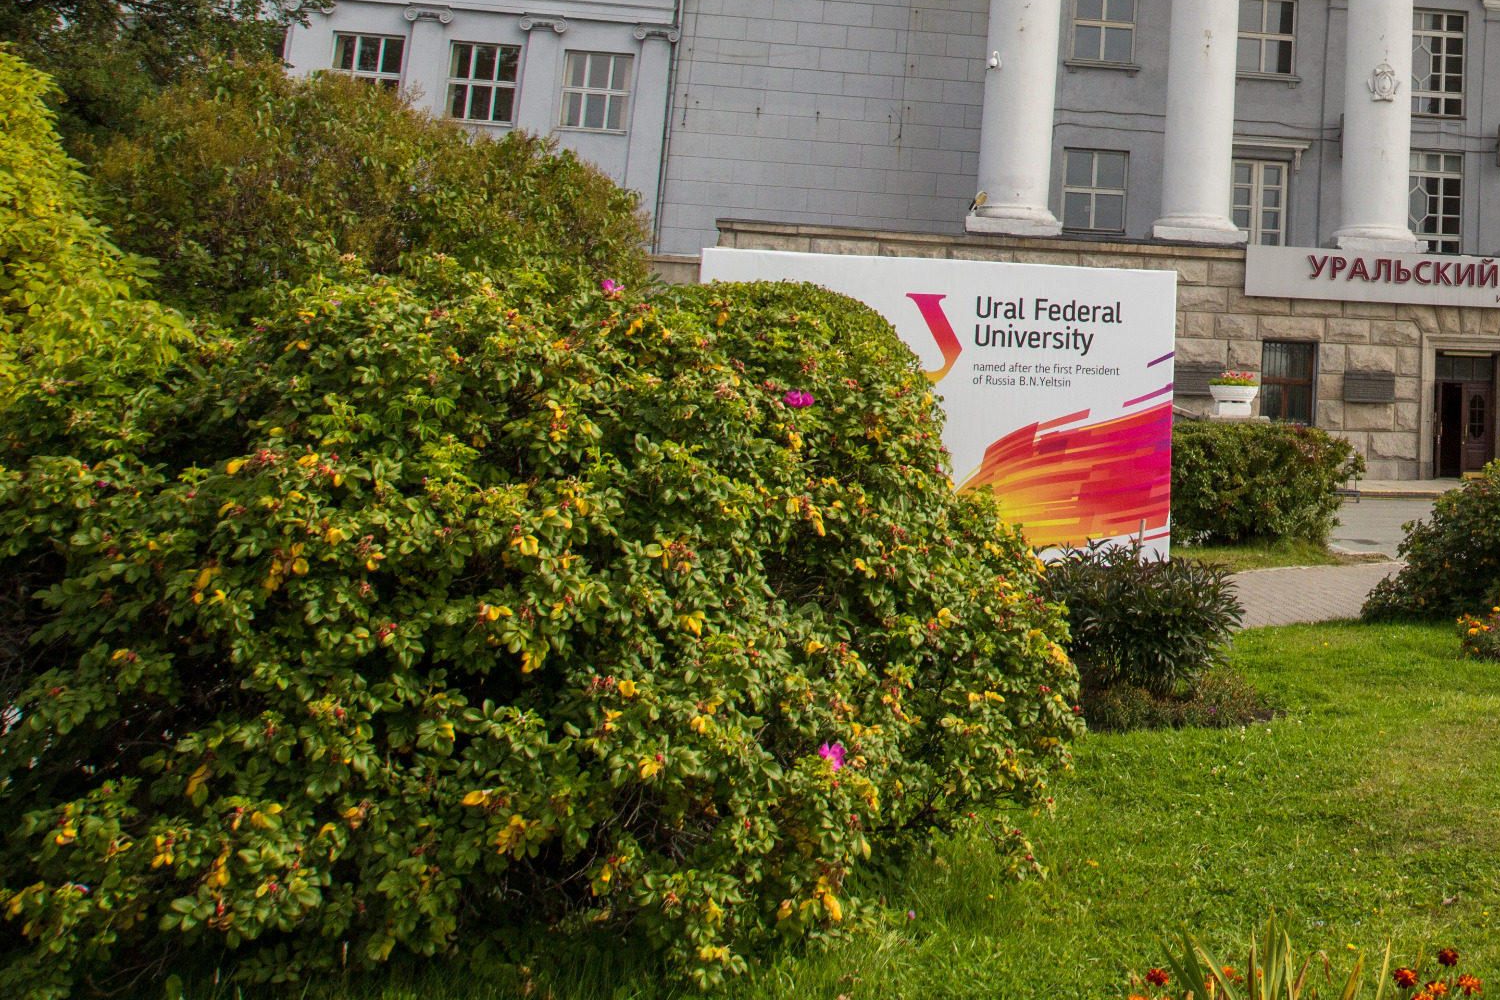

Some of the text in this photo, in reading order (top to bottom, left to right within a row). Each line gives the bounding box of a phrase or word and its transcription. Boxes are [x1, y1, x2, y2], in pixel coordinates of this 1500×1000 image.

[1307, 254, 1499, 288] УРАЛЬСКИЙ
[976, 295, 1123, 324] Ural Federal
[974, 323, 1095, 357] University
[972, 374, 983, 385] of
[985, 375, 1016, 386] Russia
[973, 362, 1121, 376] named after the first President
